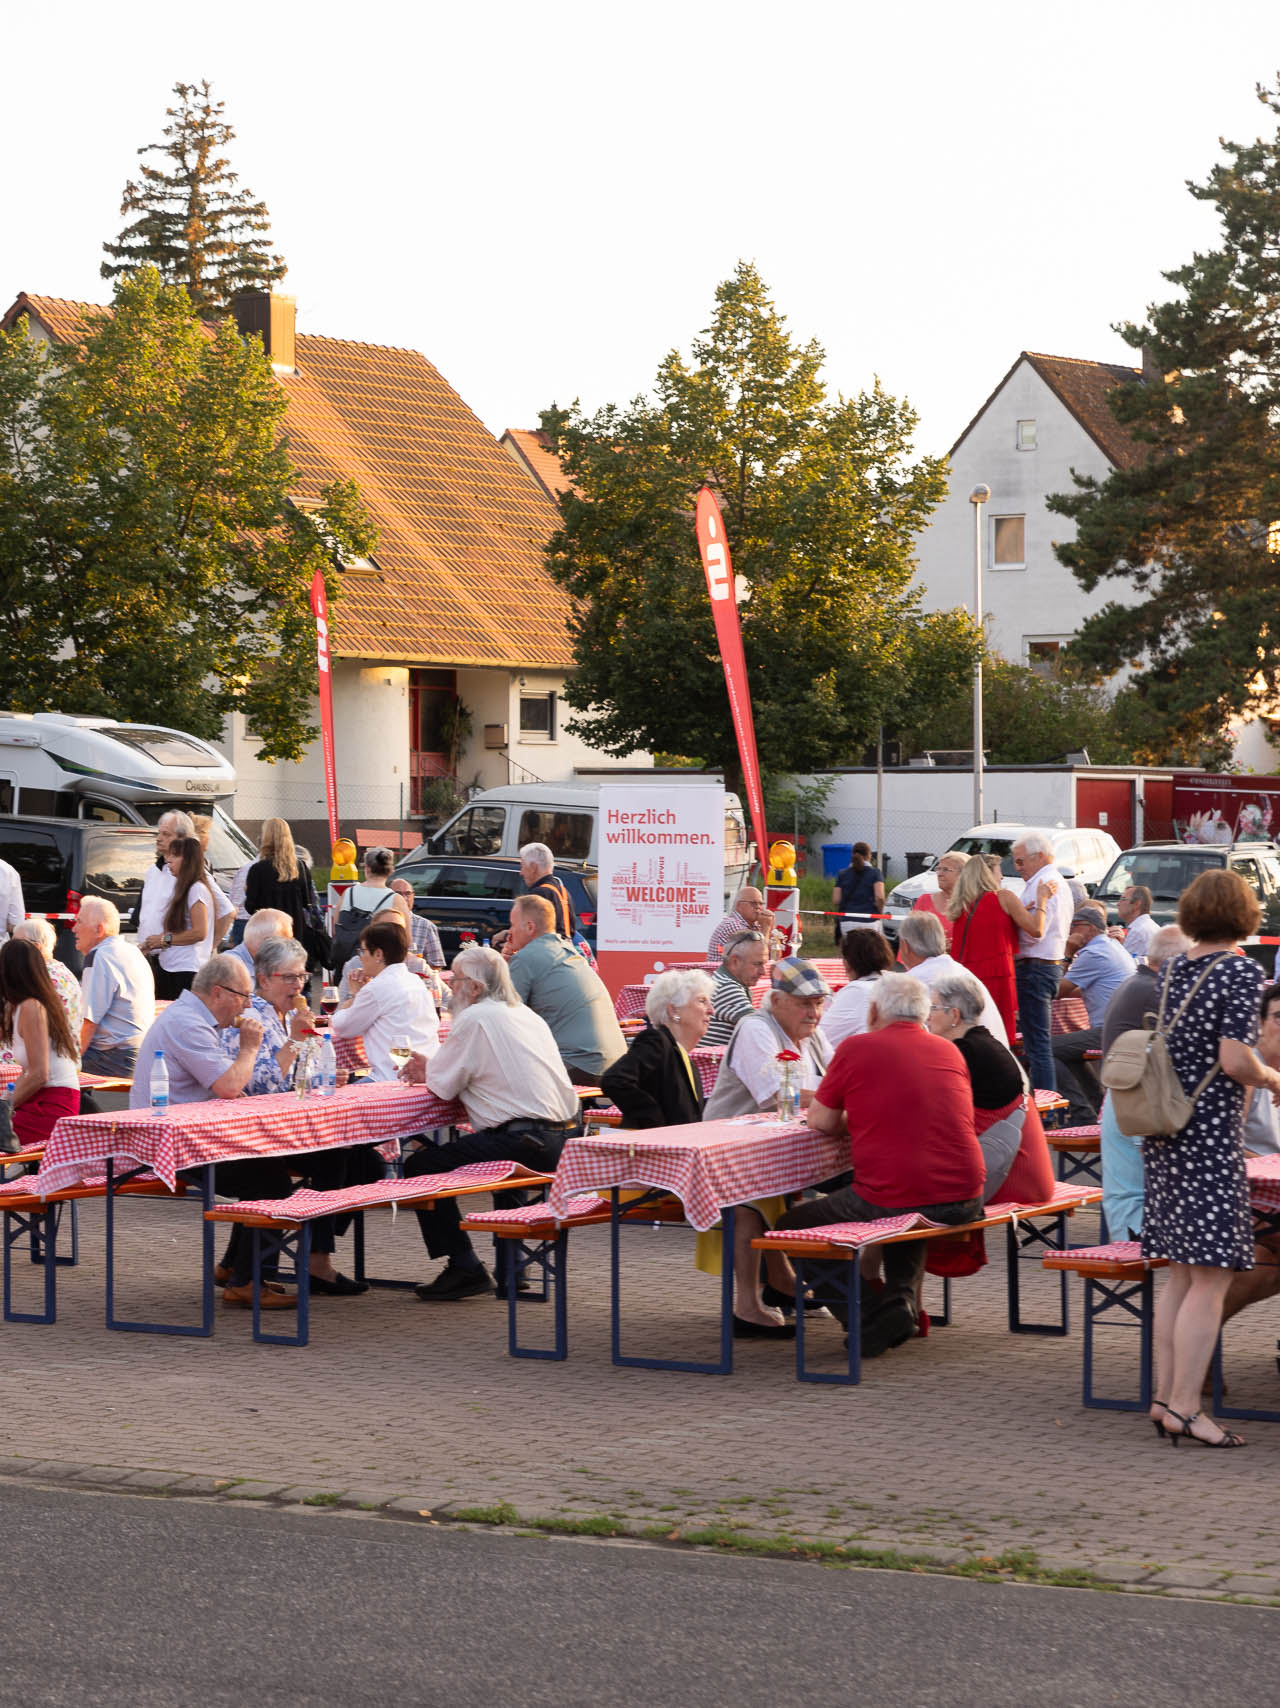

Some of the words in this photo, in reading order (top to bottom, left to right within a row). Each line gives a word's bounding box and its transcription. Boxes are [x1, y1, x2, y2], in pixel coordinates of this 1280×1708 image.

[607, 808, 676, 824] Herzlich
[606, 828, 716, 845] willkommen.
[626, 886, 696, 903] WELCOME
[682, 903, 710, 915] SALVE
